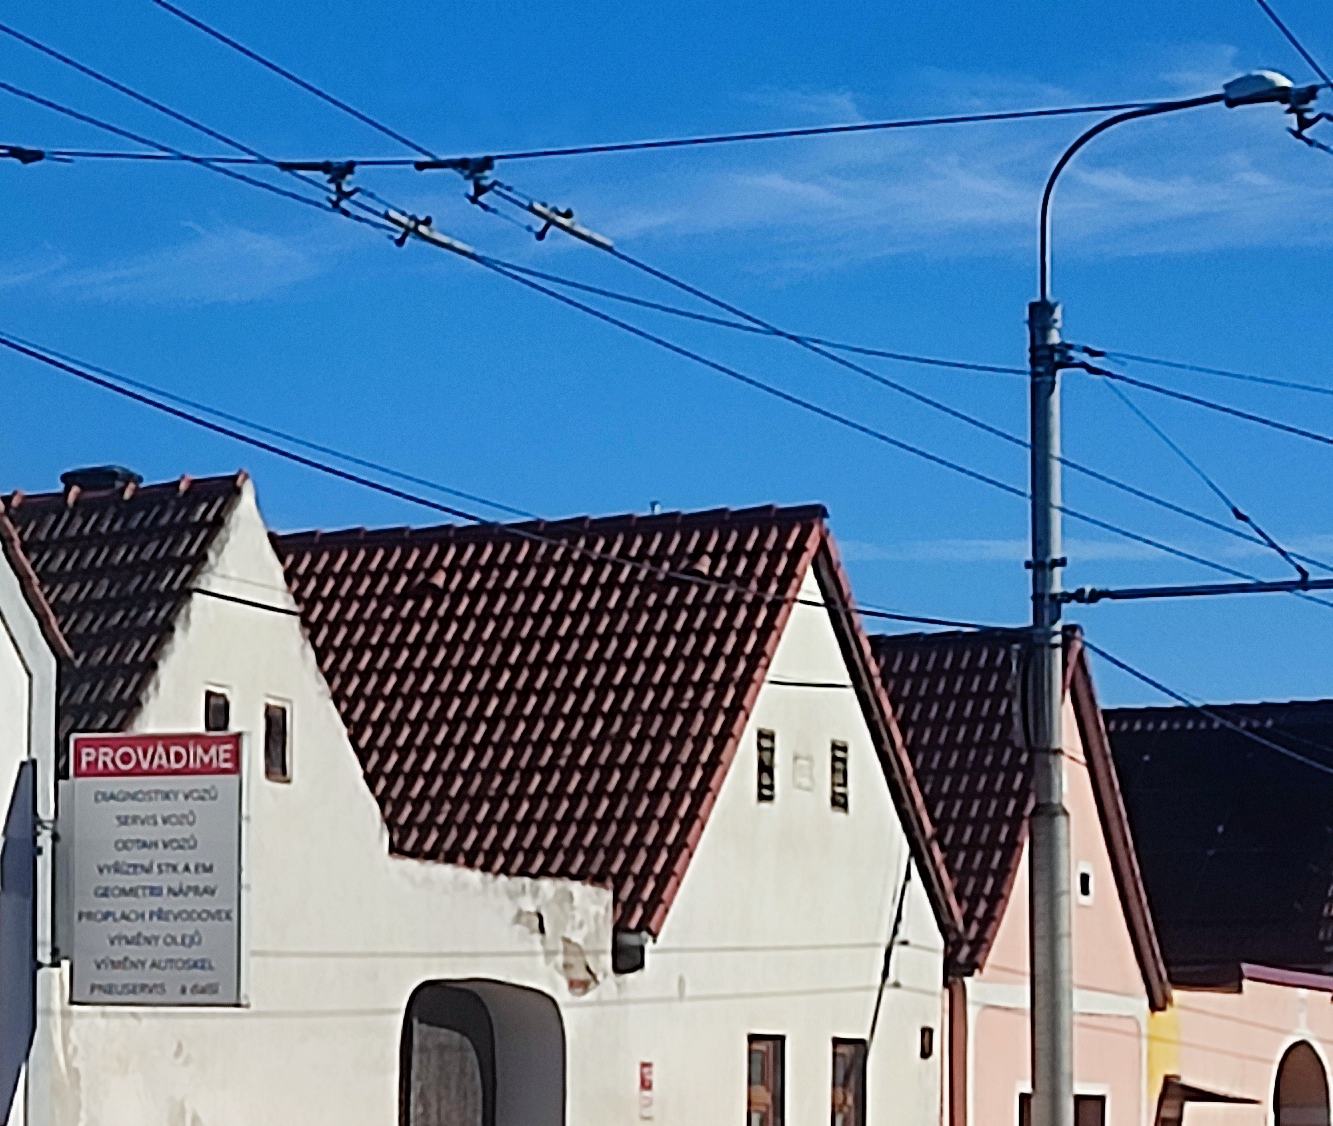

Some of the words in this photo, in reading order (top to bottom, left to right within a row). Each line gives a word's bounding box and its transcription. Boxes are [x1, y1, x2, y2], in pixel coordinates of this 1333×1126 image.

[80, 741, 233, 771] PROVÁDÍME
[93, 789, 179, 803] DIAGNOSTIKY
[115, 813, 157, 827] SERVIS
[113, 838, 159, 852] ODTAH
[157, 862, 179, 875] STK
[182, 862, 191, 874] A
[77, 909, 146, 923] PROPLACH
[89, 982, 167, 995] PNEUSERVIS
